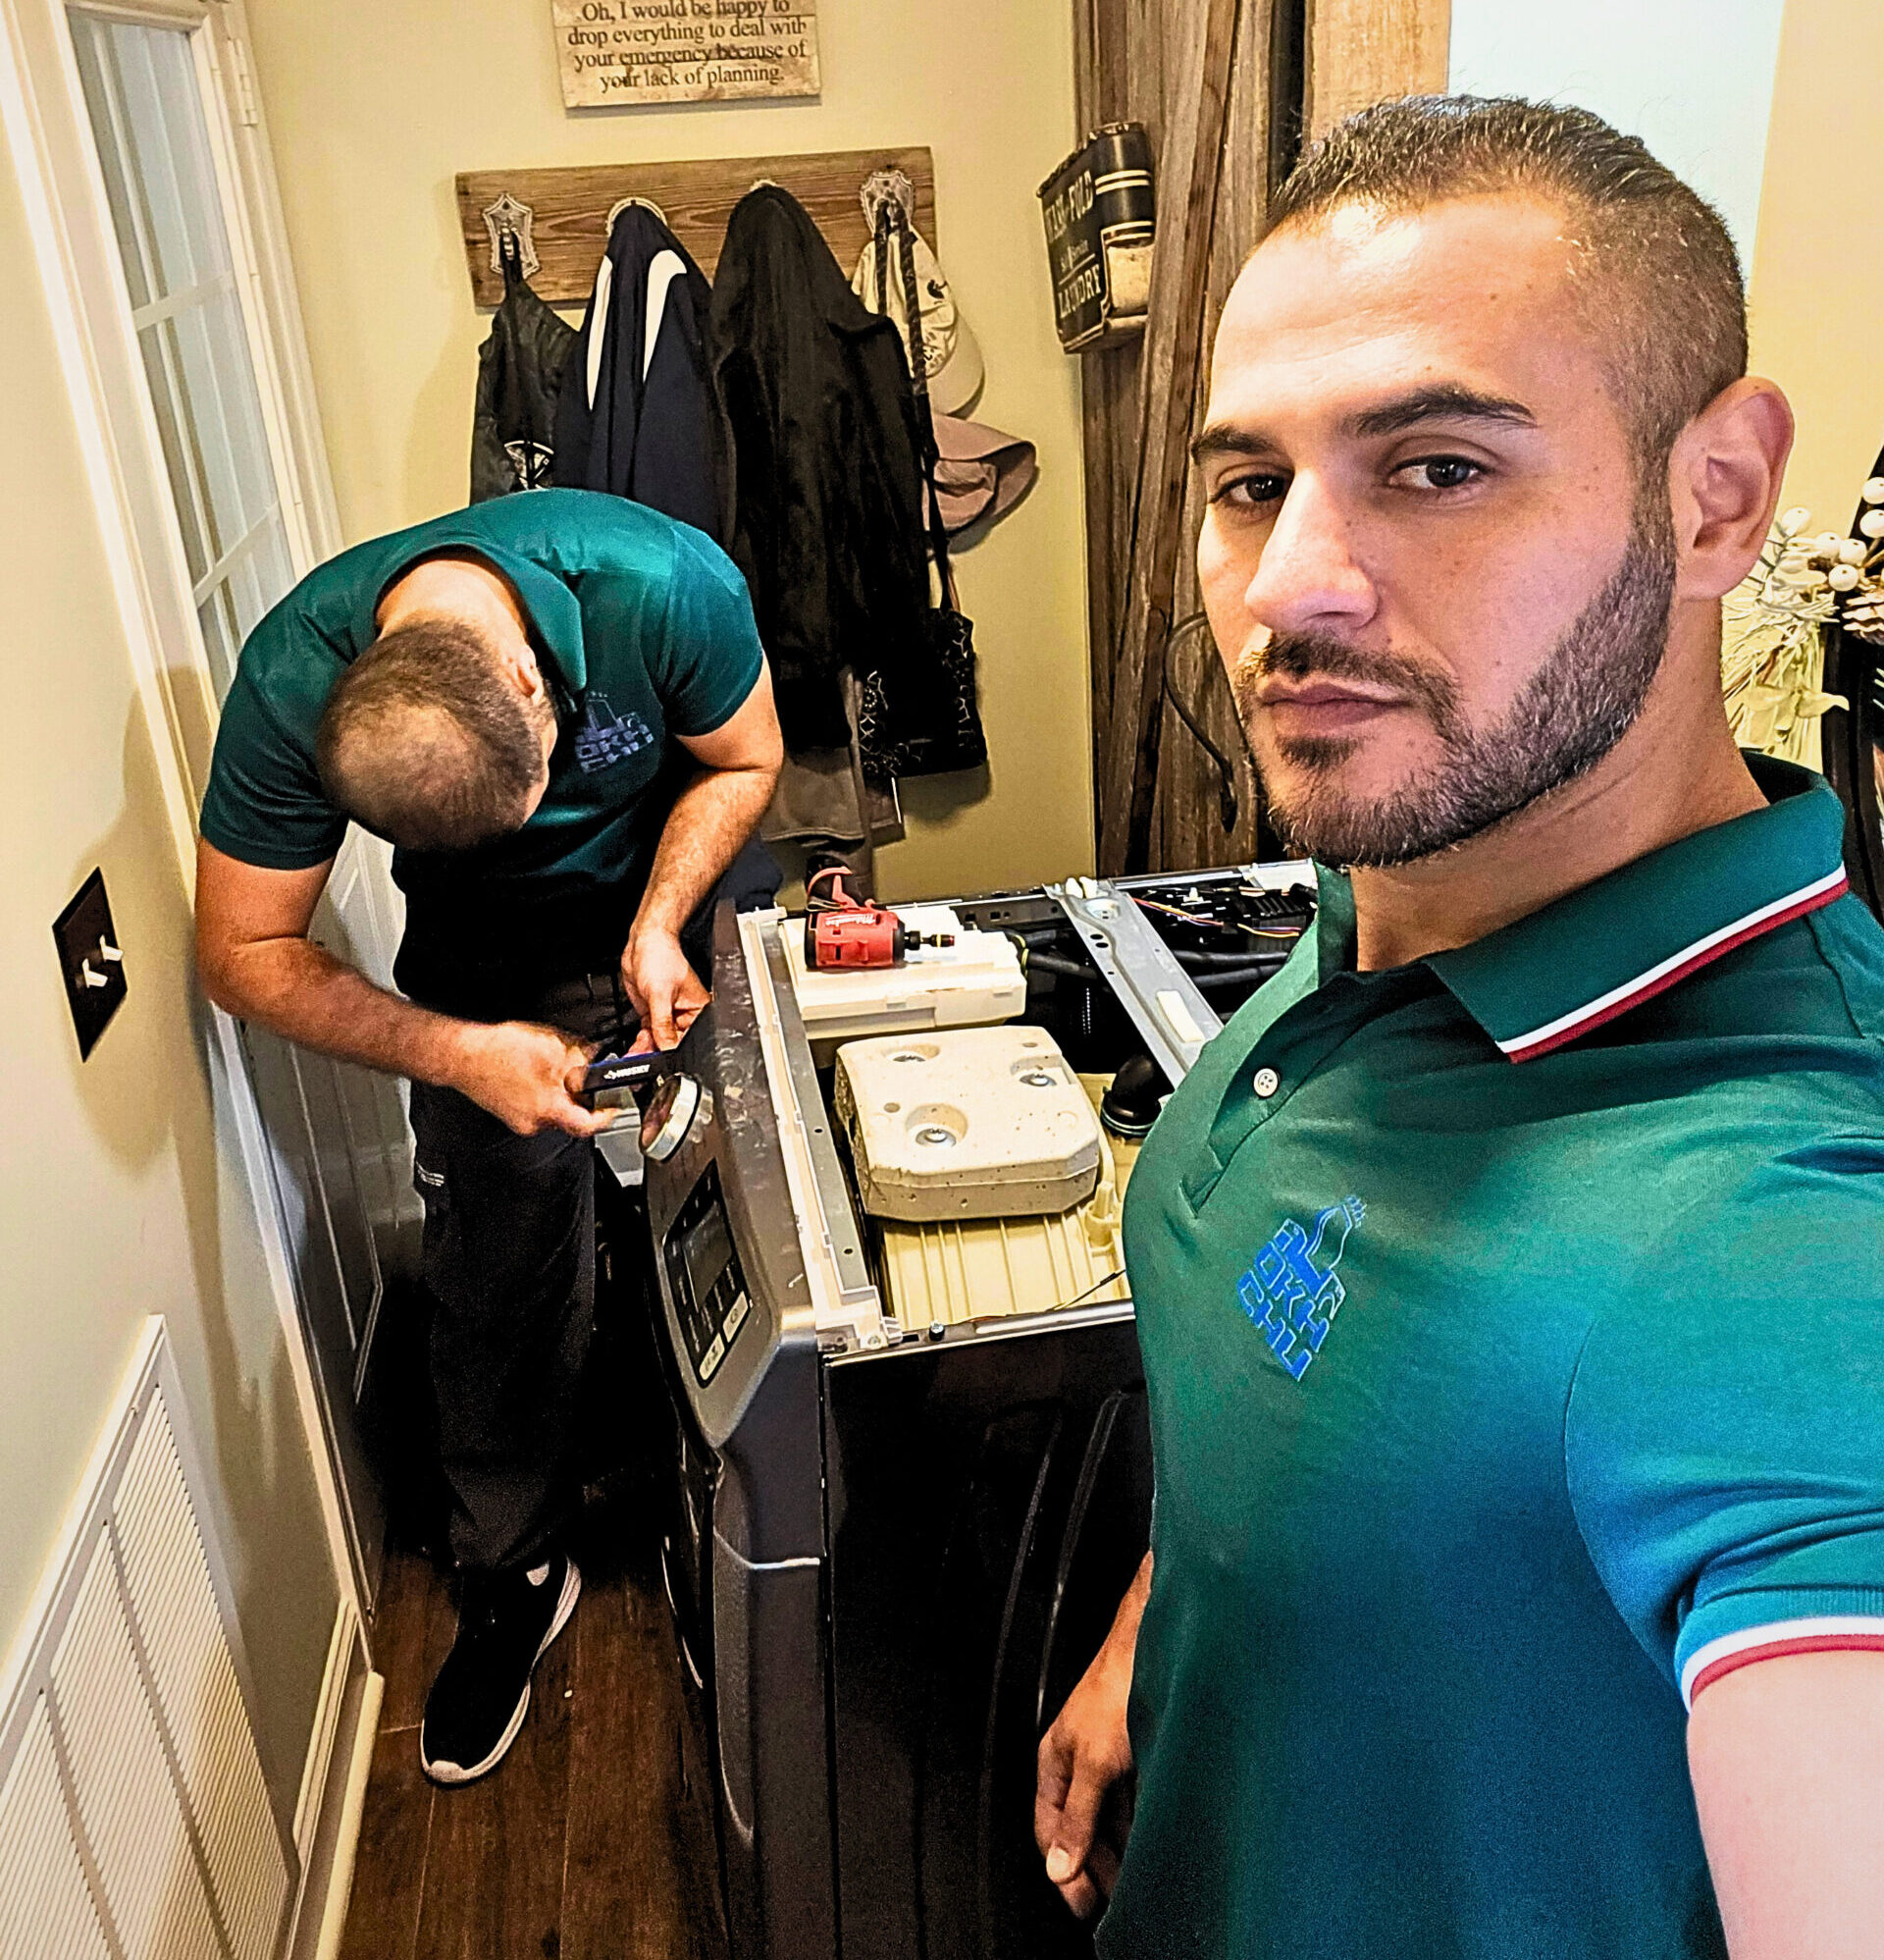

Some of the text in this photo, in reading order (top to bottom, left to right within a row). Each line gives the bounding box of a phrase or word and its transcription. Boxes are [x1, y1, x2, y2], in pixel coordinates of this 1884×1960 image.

[582, 0, 789, 25] Oh, I would be happy to
[568, 15, 808, 49] drop everything to deal with
[573, 38, 810, 74] your emergency because of
[599, 63, 785, 94] your lack of planning.
